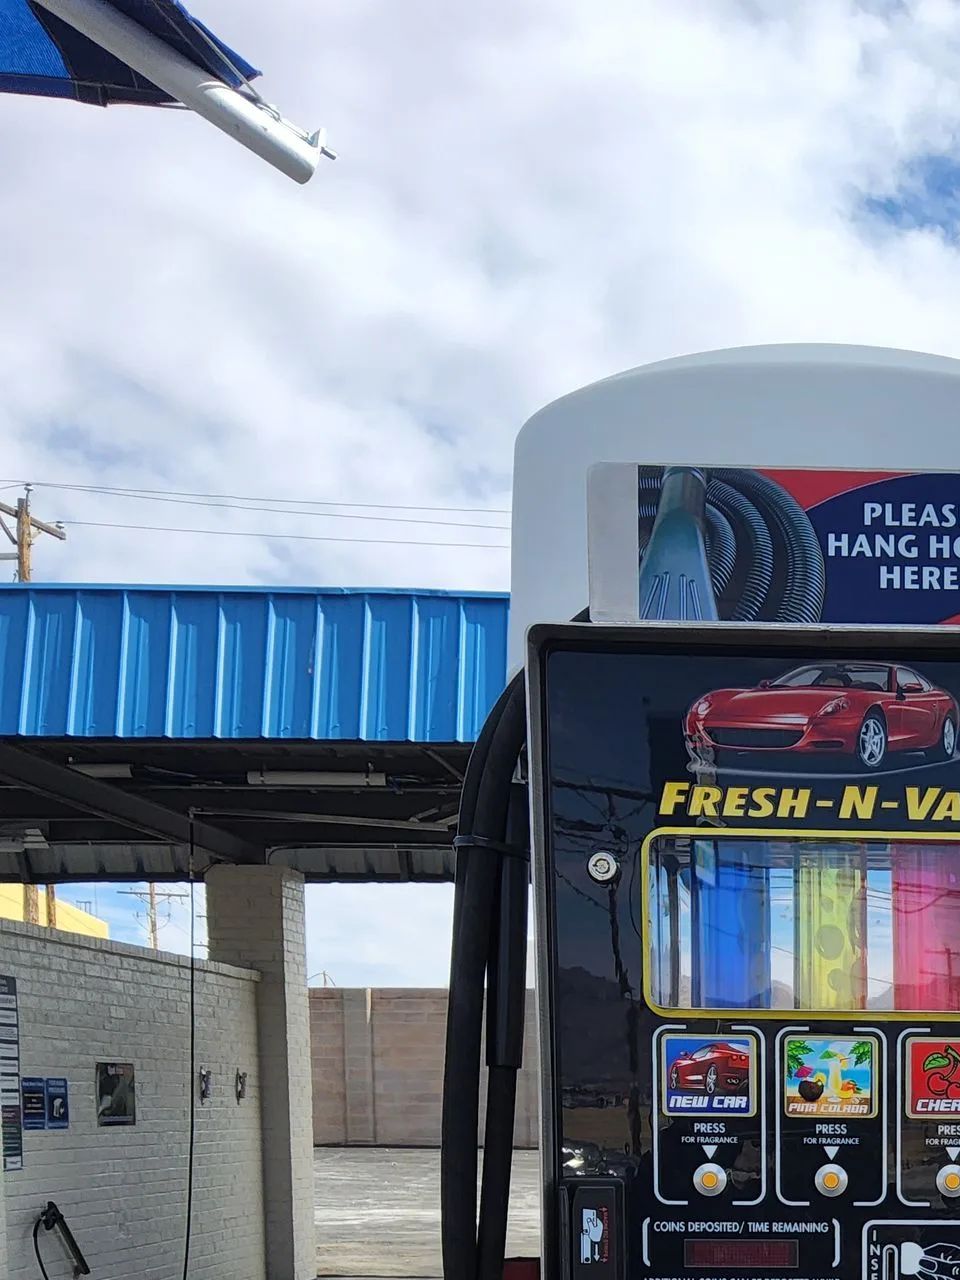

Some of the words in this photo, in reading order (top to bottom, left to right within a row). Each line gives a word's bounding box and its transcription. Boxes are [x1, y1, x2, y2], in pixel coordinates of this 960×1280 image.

[828, 533, 918, 558] HANG
[880, 566, 958, 590] HERE
[669, 1096, 708, 1108] NEW
[712, 1096, 748, 1108] CAR
[820, 1103, 869, 1113] COLADA
[694, 1123, 726, 1133] PRESS
[816, 1124, 847, 1135] PRESS
[654, 1221, 685, 1232] COINS
[688, 1222, 744, 1234] DEPOSITED/
[749, 1222, 769, 1233] TIME
[773, 1222, 829, 1233] REMAINING
